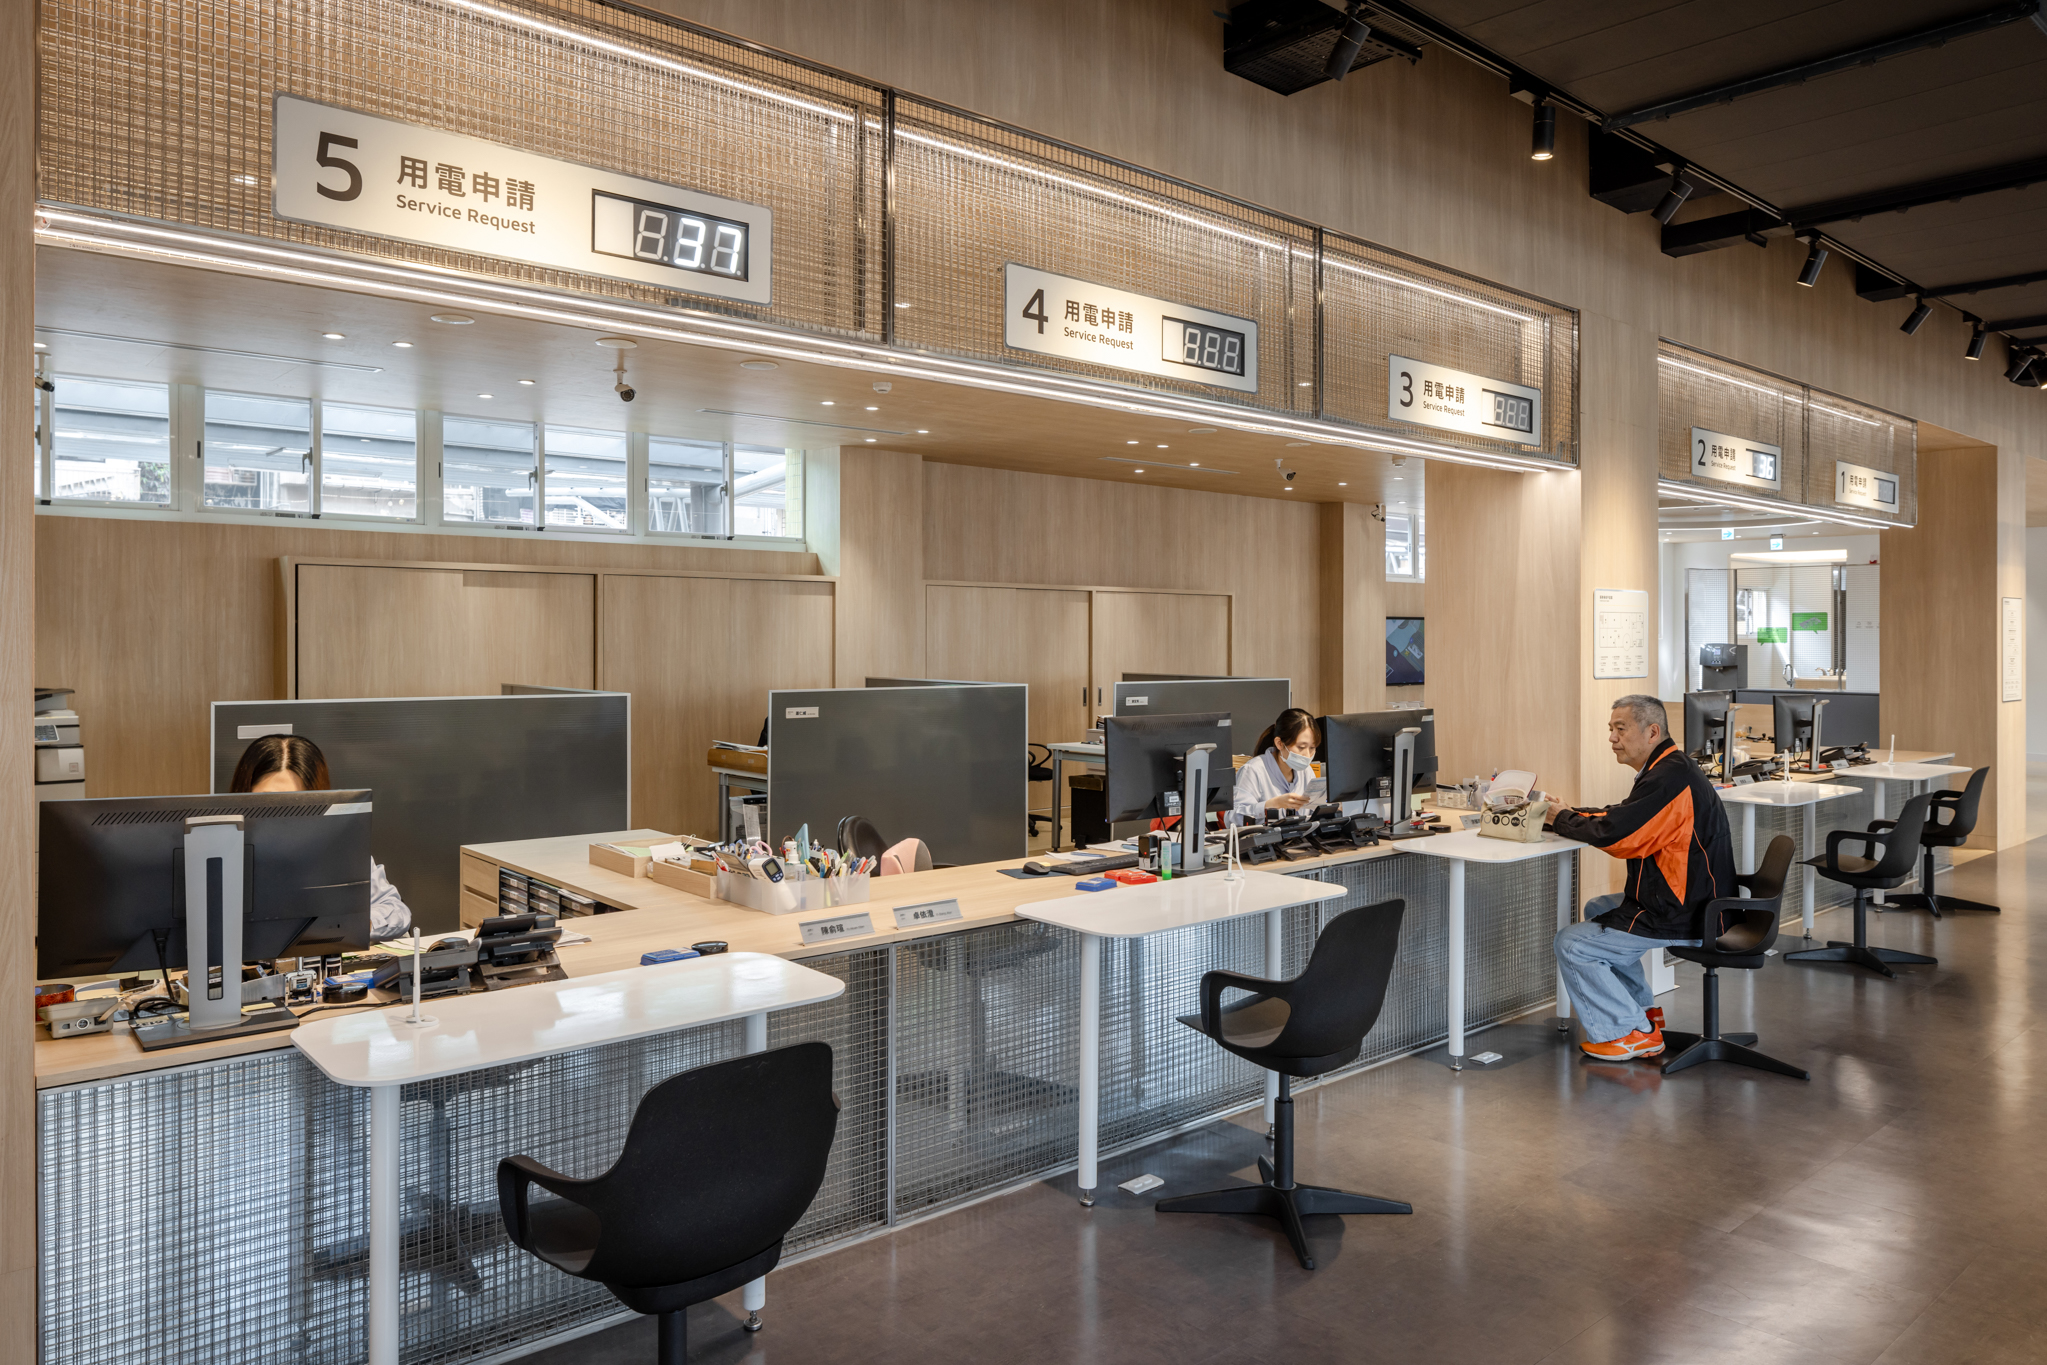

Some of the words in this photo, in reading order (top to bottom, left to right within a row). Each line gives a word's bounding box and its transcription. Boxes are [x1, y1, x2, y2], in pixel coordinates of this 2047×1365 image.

[316, 131, 362, 202] 5
[397, 155, 536, 212] 用電申請
[396, 194, 461, 219] Service
[467, 208, 536, 234] Request
[1022, 288, 1049, 335] 4
[1064, 299, 1134, 334] 用電申請
[1064, 326, 1097, 343] Service
[1099, 334, 1134, 351] Request
[1400, 371, 1414, 407] 3
[1423, 379, 1465, 404] 用電申請
[1423, 400, 1443, 413] Service
[1443, 406, 1465, 417] Request
[1697, 438, 1706, 466] 2
[1841, 471, 1845, 493] 1
